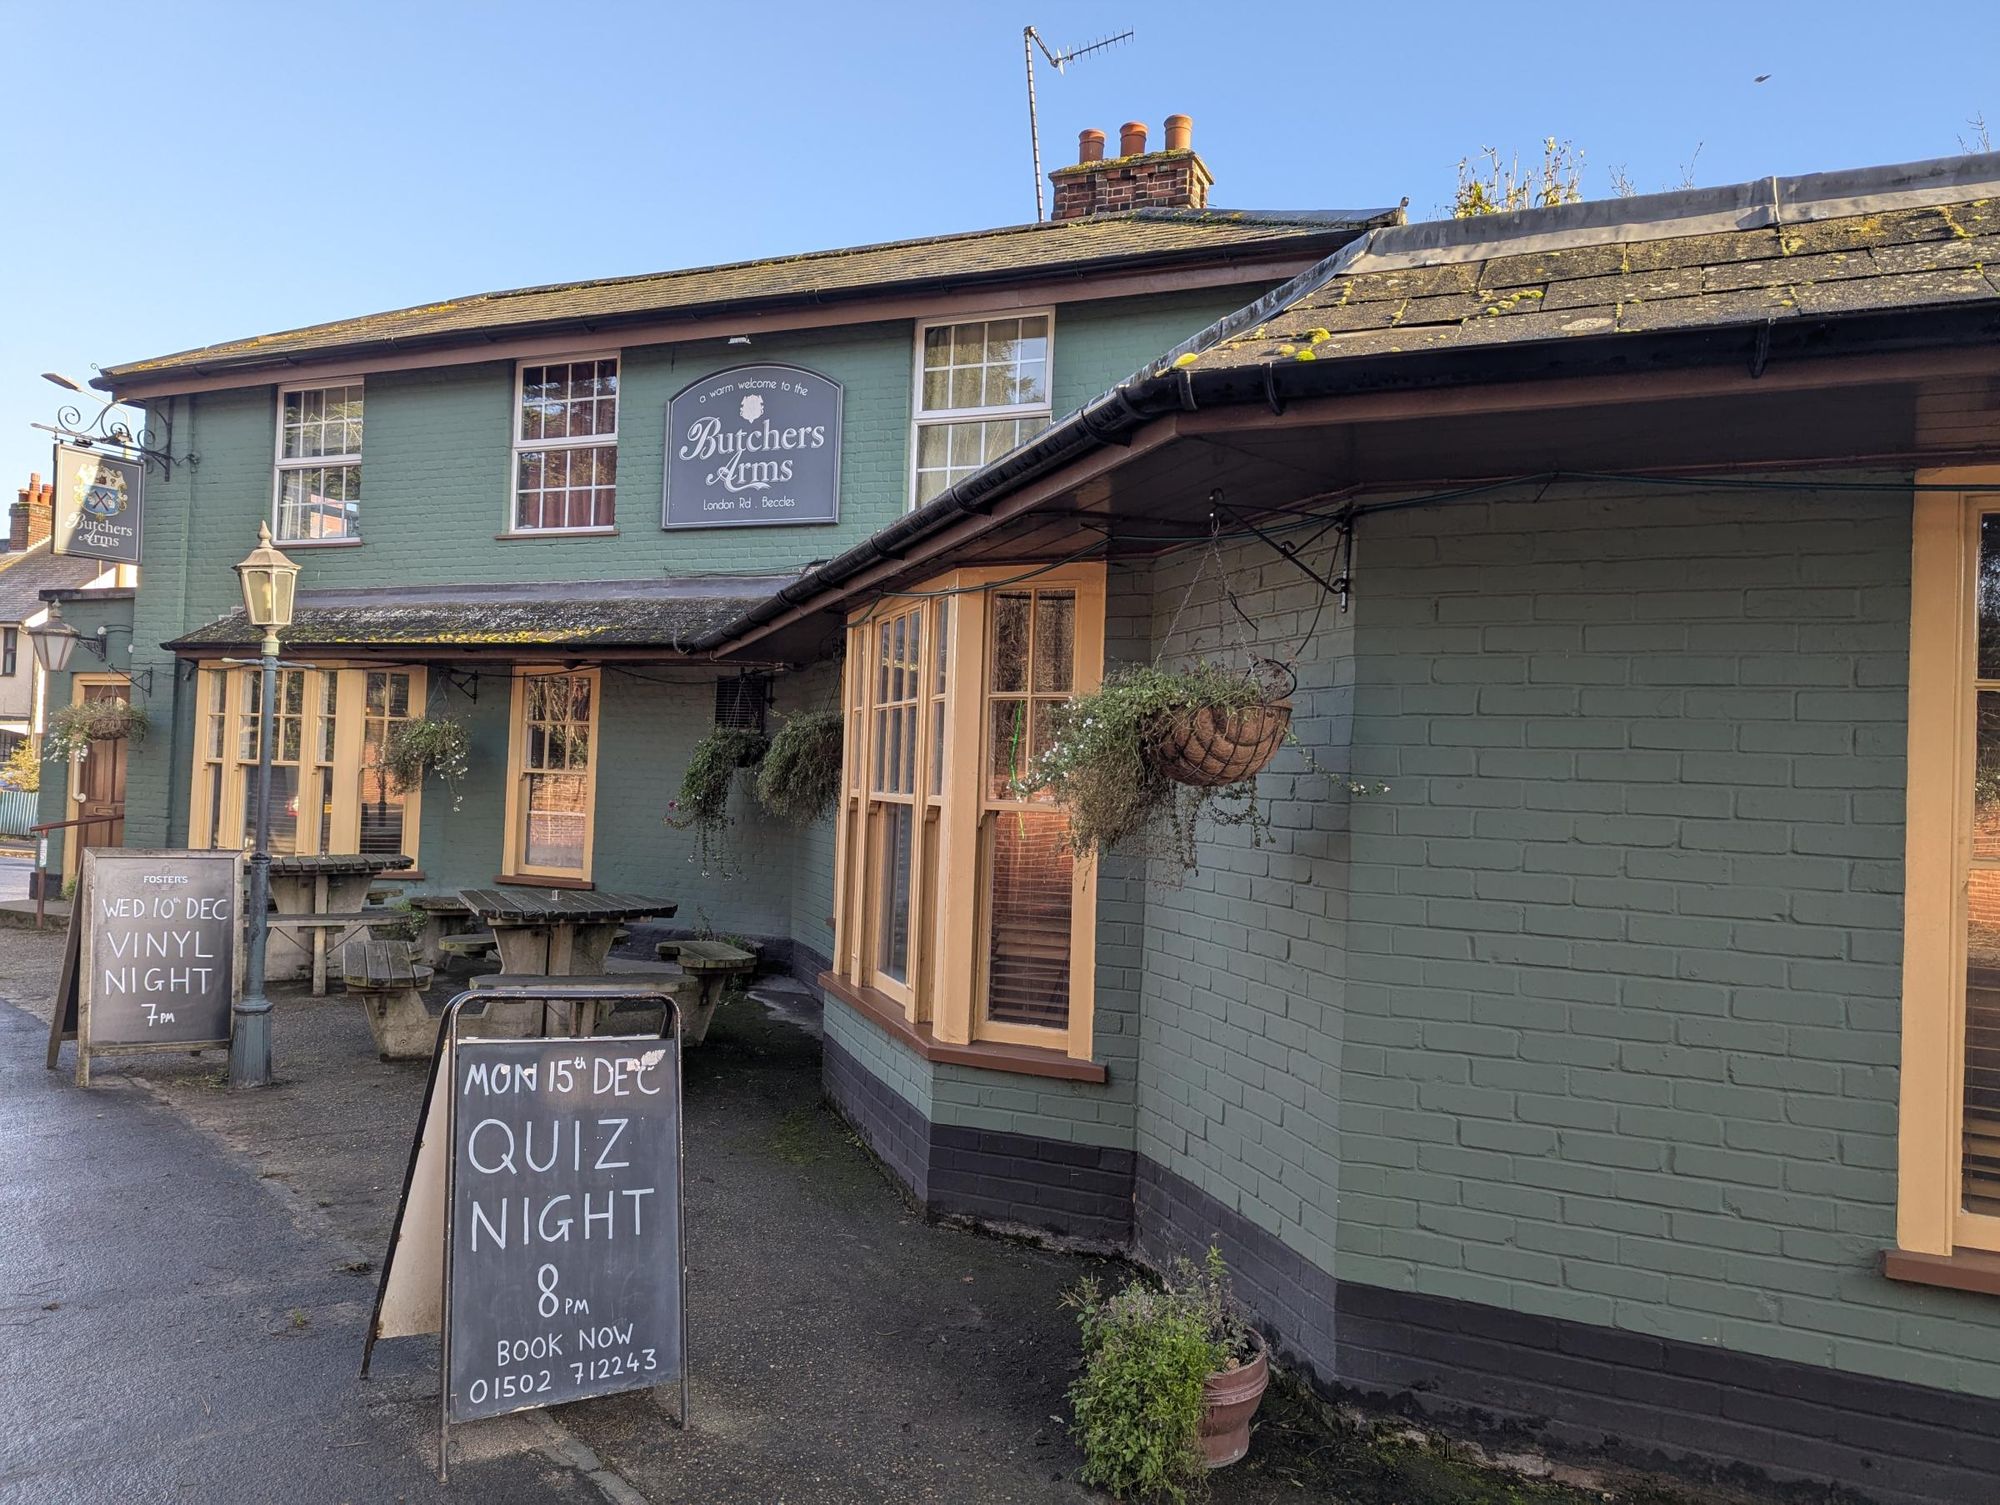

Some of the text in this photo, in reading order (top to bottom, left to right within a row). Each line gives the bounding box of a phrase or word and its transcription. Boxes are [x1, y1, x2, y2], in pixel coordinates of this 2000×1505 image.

[700, 377, 808, 403] a warm welcome to the
[679, 416, 825, 461] Butchers
[705, 450, 793, 493] Arms
[703, 498, 735, 511] London
[762, 495, 796, 508] Beccles
[65, 511, 133, 537] Butchers
[78, 528, 120, 548] Arms
[102, 898, 145, 918] WED
[186, 898, 228, 921] DEC
[107, 931, 214, 959] VINYL
[105, 967, 213, 995] NIGHT
[463, 1062, 538, 1096] MON
[593, 1057, 661, 1096] DEC
[467, 1117, 630, 1176] QUIZ
[471, 1187, 655, 1253] NIGHT
[497, 1323, 634, 1367] BOOK NOW
[469, 1348, 657, 1404] 01502 712243
